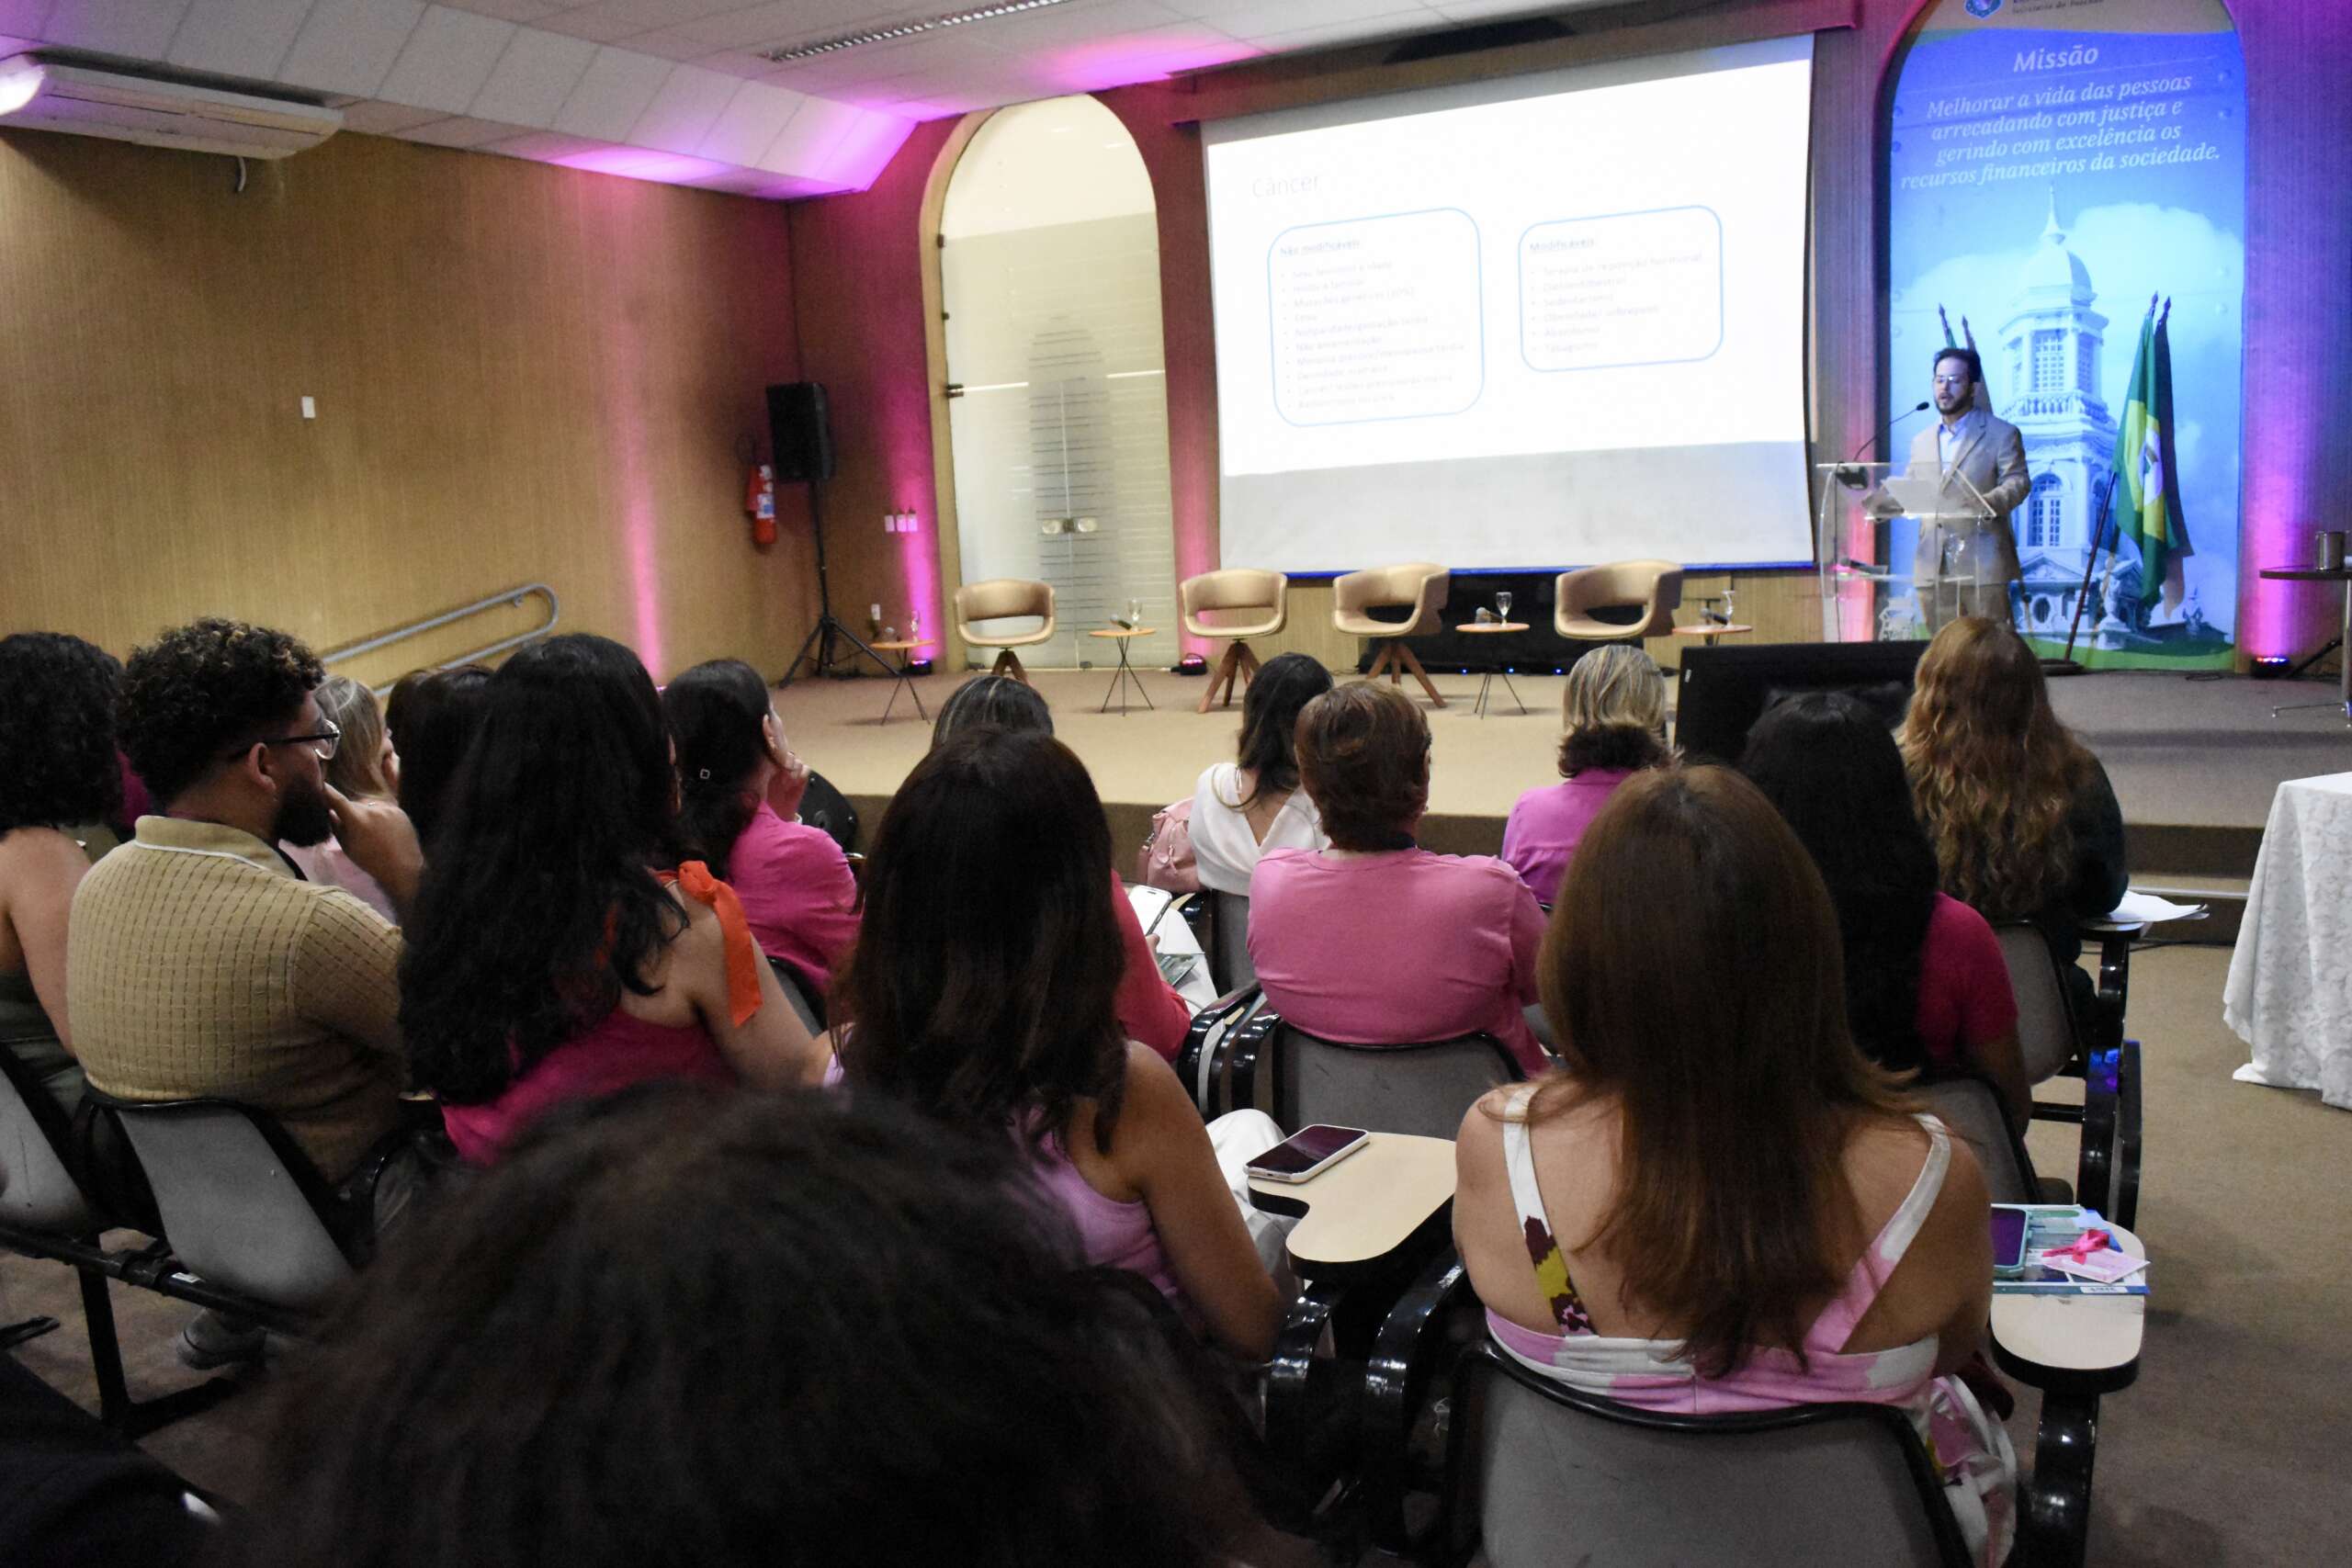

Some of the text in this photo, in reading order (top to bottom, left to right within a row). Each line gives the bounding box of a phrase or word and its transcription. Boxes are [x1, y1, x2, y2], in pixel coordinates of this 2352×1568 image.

[2013, 44, 2098, 73] Missão
[1927, 75, 2192, 118] Melhorar a vida das pessoas
[1931, 100, 2183, 140] arrecadando com justiça e
[1901, 141, 2221, 189] recursos financeiros da sociedade.
[1935, 125, 2181, 167] gerindo com excelência os
